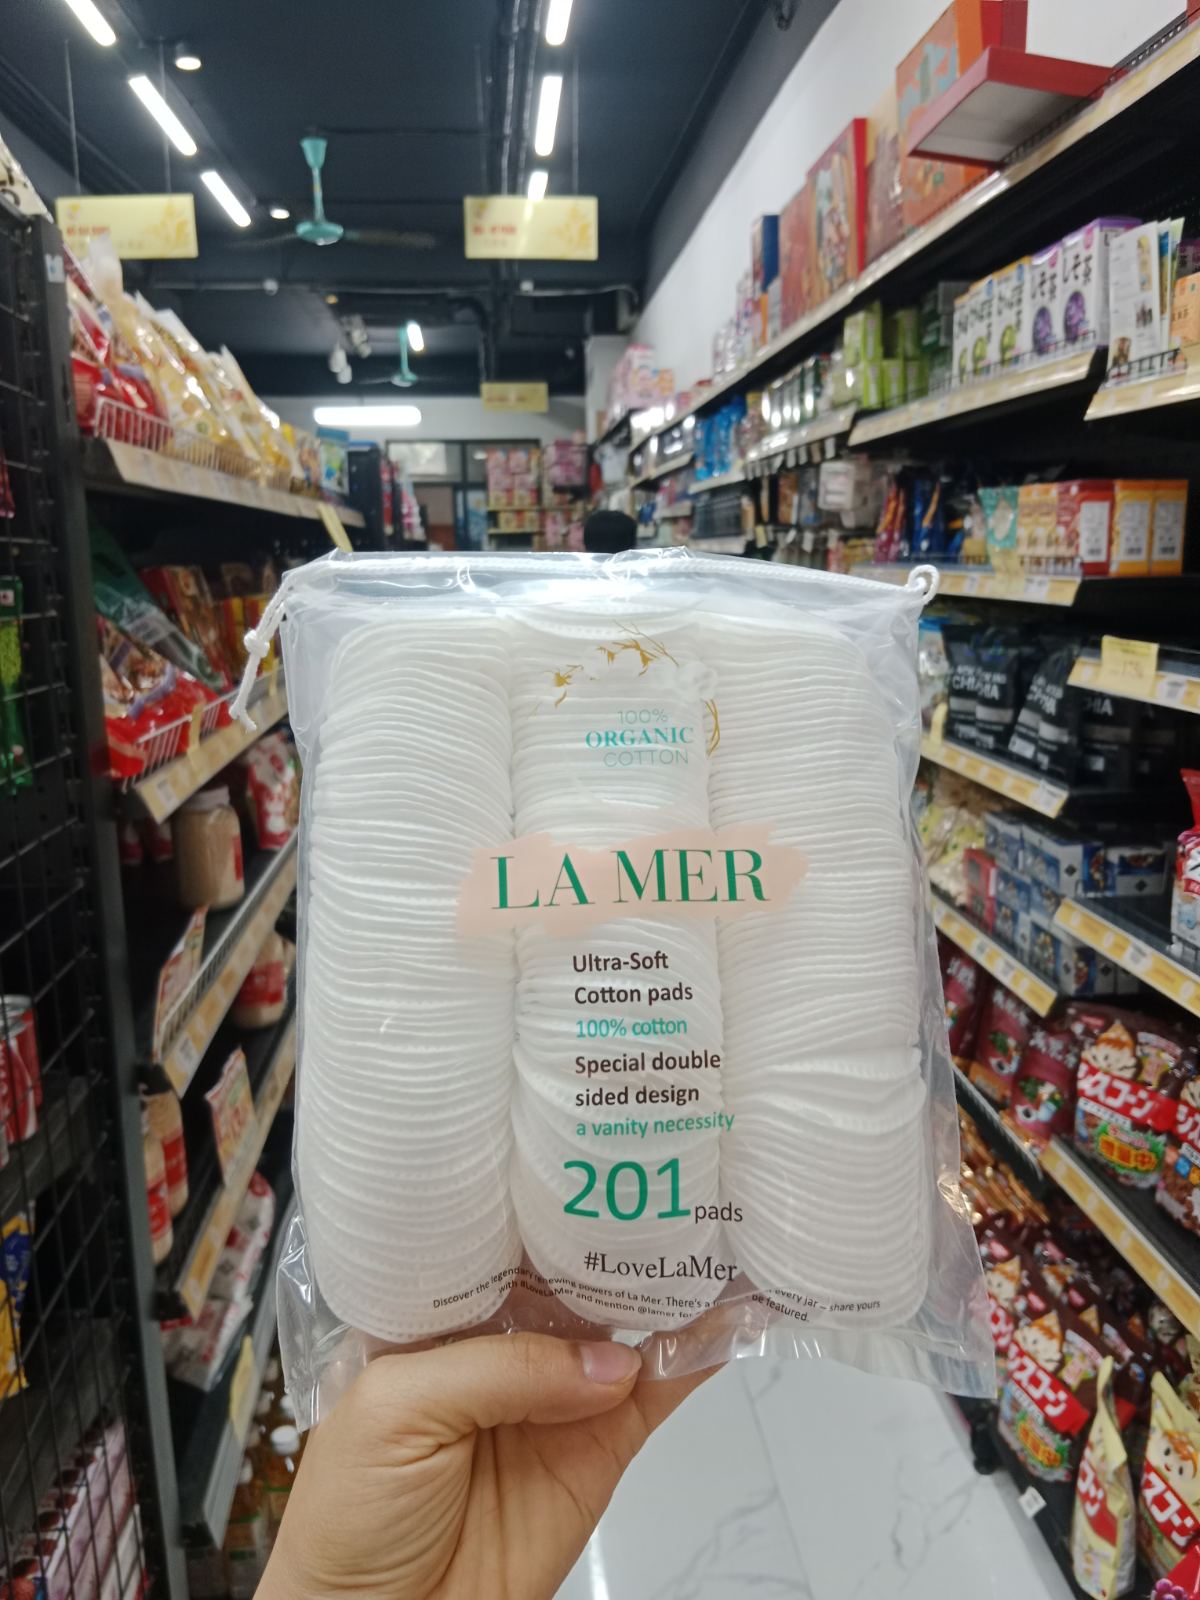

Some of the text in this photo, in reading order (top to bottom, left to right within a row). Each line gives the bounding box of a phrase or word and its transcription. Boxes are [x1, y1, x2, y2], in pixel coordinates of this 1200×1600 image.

[617, 708, 669, 725] 100%
[585, 726, 695, 749] ORGANIC
[603, 749, 689, 768] COTTON
[490, 848, 771, 910] LA MER
[572, 950, 669, 973] Ultra-Soft
[574, 982, 694, 1006] Cotton pads
[575, 1018, 688, 1039] 100% cotton
[575, 1049, 721, 1079] Special double
[575, 1084, 700, 1107] sided design
[575, 1111, 736, 1139] a vanity necessity
[563, 1158, 744, 1224] 201 pads
[583, 1251, 738, 1282] #LoveLaMer
[432, 1288, 475, 1309] Discover
[476, 1281, 491, 1294] the
[490, 1265, 533, 1284] legendary
[578, 1282, 613, 1297] powers
[614, 1290, 626, 1299] of
[627, 1291, 638, 1301] La
[666, 1296, 702, 1309] There's
[774, 1288, 802, 1302] every
[803, 1297, 819, 1310] jar
[828, 1303, 855, 1312] share
[855, 1299, 881, 1312] yours
[498, 1280, 518, 1295] with
[575, 1292, 593, 1303] and
[594, 1298, 635, 1312] mention
[637, 1305, 677, 1318] @lamer
